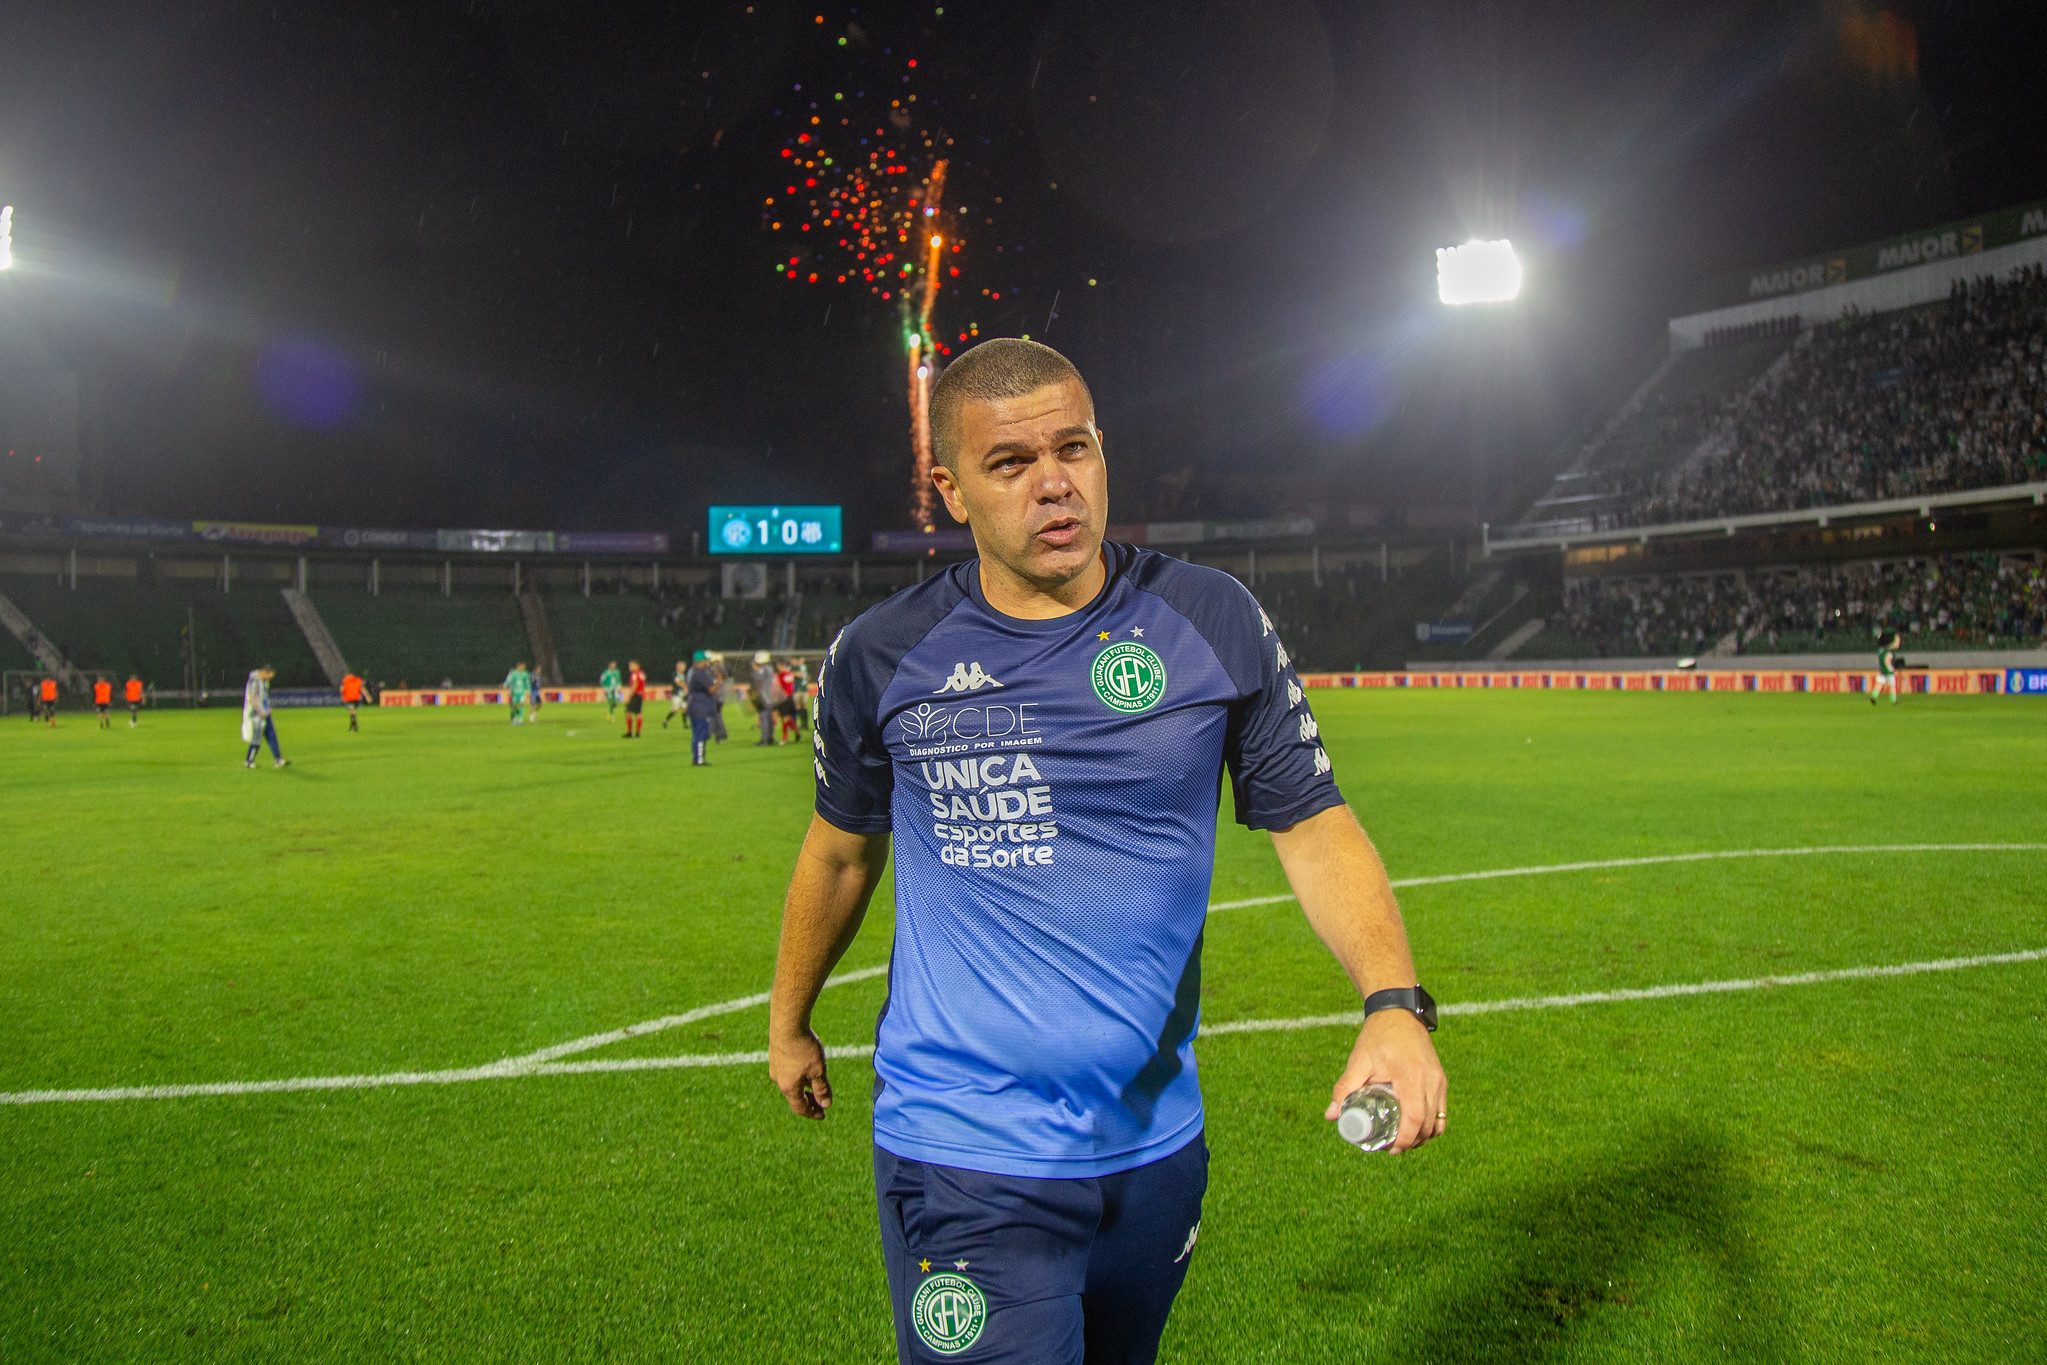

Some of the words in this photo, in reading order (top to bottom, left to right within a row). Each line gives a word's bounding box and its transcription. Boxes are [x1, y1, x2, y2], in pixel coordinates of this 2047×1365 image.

[1878, 231, 1959, 270] MAIOR
[1750, 264, 1825, 295] MAIOR
[757, 519, 769, 545] 1
[781, 519, 798, 545] 0
[1096, 654, 1111, 687] GUARANI
[1110, 645, 1145, 657] FUTEBOL
[1146, 654, 1162, 680] CLUBE
[1103, 691, 1143, 708] CAMPINAS
[1146, 687, 1160, 702] 1911
[953, 703, 1041, 739] CDE
[910, 744, 969, 757] DIAGNOSTICO
[974, 741, 995, 749] POR
[1001, 737, 1043, 747] IMAGEM
[921, 753, 1042, 790] ÚNICA
[930, 786, 1054, 822] SAÚDE
[934, 821, 1059, 848] esportes
[916, 1286, 931, 1325] GUARANI
[930, 1278, 966, 1292] FUTEBOL
[967, 1288, 982, 1317] CLUBE
[923, 1330, 961, 1350] CAMPINAS
[965, 1323, 978, 1340] 1911
